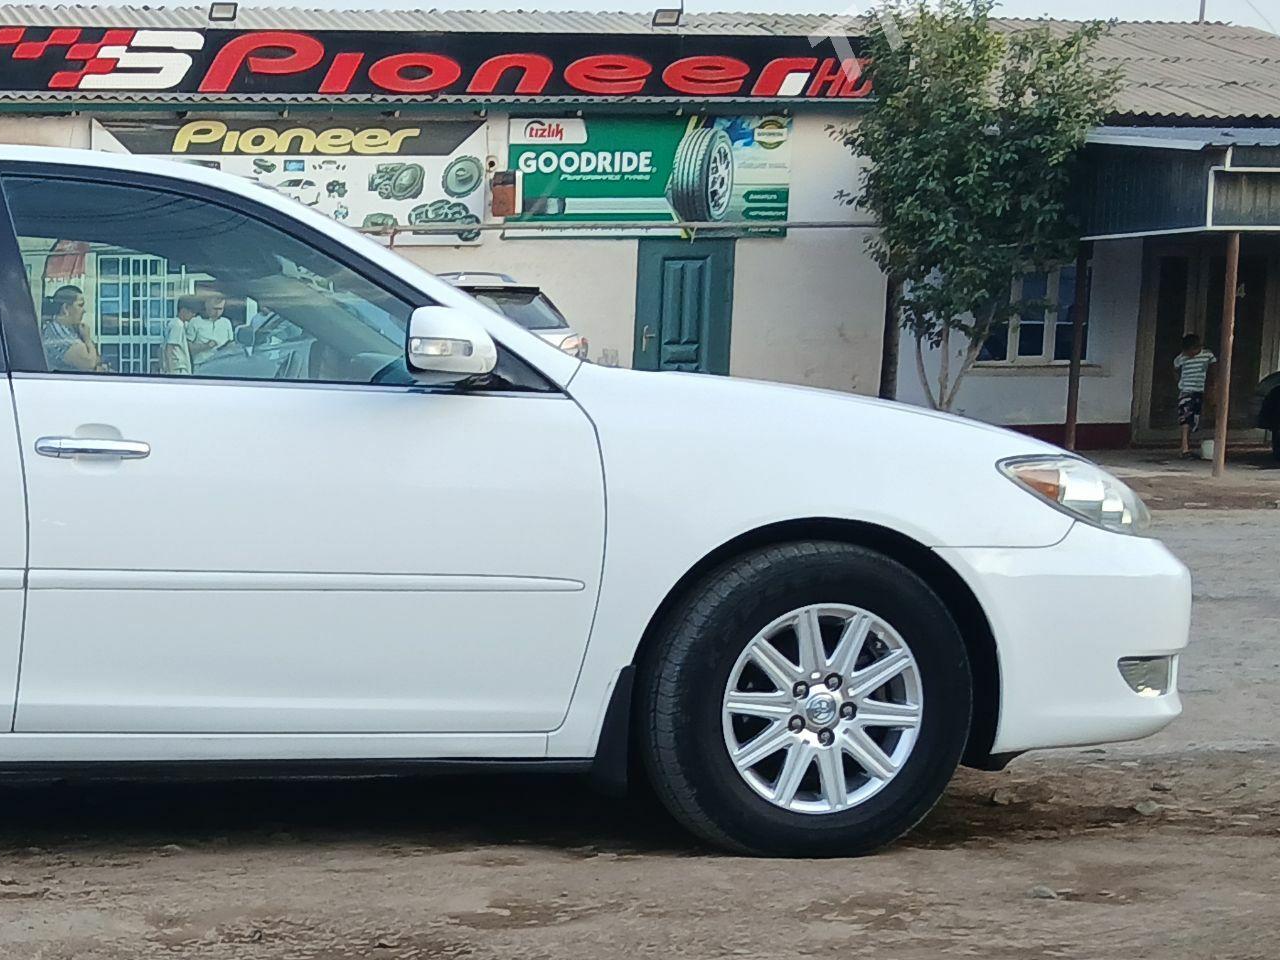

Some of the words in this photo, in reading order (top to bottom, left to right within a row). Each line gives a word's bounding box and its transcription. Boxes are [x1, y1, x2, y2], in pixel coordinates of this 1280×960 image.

[198, 31, 818, 98] Pioneer
[172, 120, 420, 155] Pioneer
[518, 151, 654, 174] GOODRIDE
